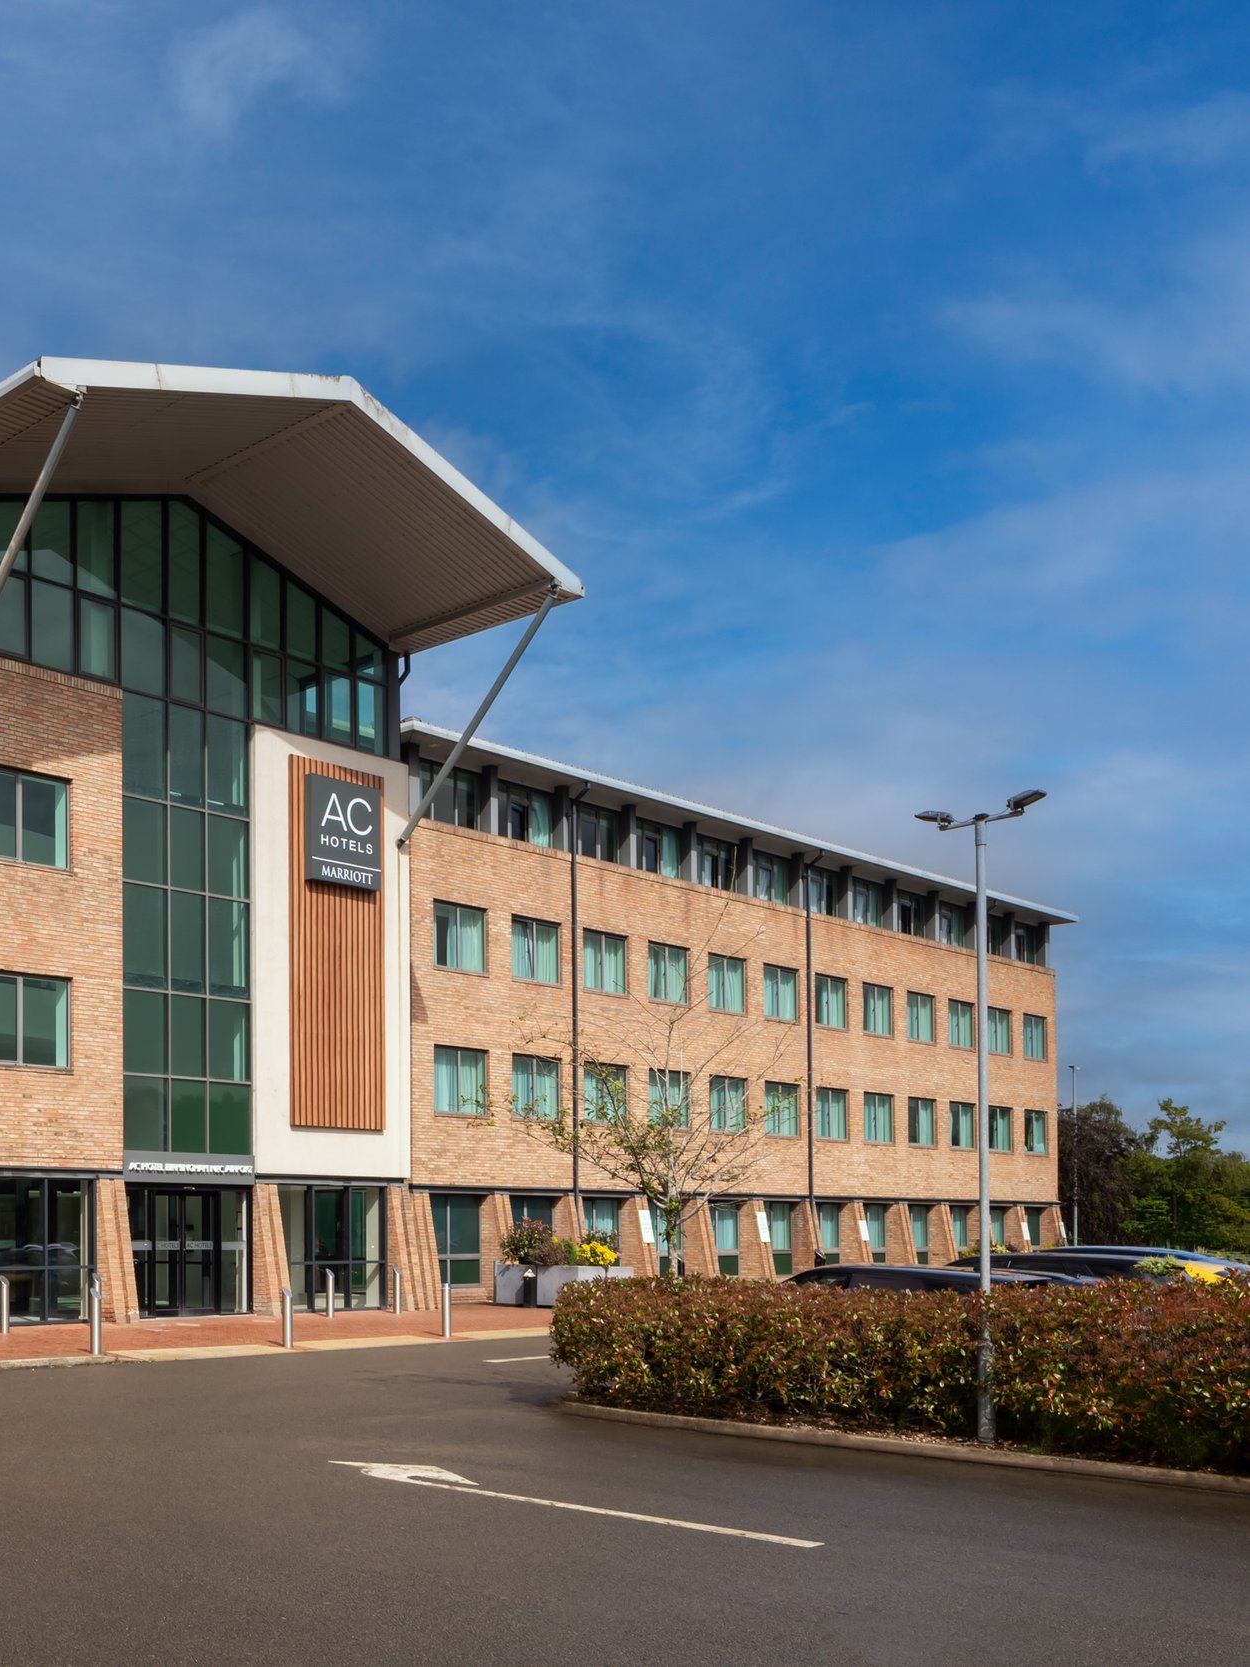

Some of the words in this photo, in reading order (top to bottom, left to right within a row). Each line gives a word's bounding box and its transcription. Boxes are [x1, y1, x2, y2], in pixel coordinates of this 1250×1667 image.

[320, 792, 373, 836] AC
[320, 833, 373, 855] HOTELS
[321, 864, 374, 885] MARRIOTT
